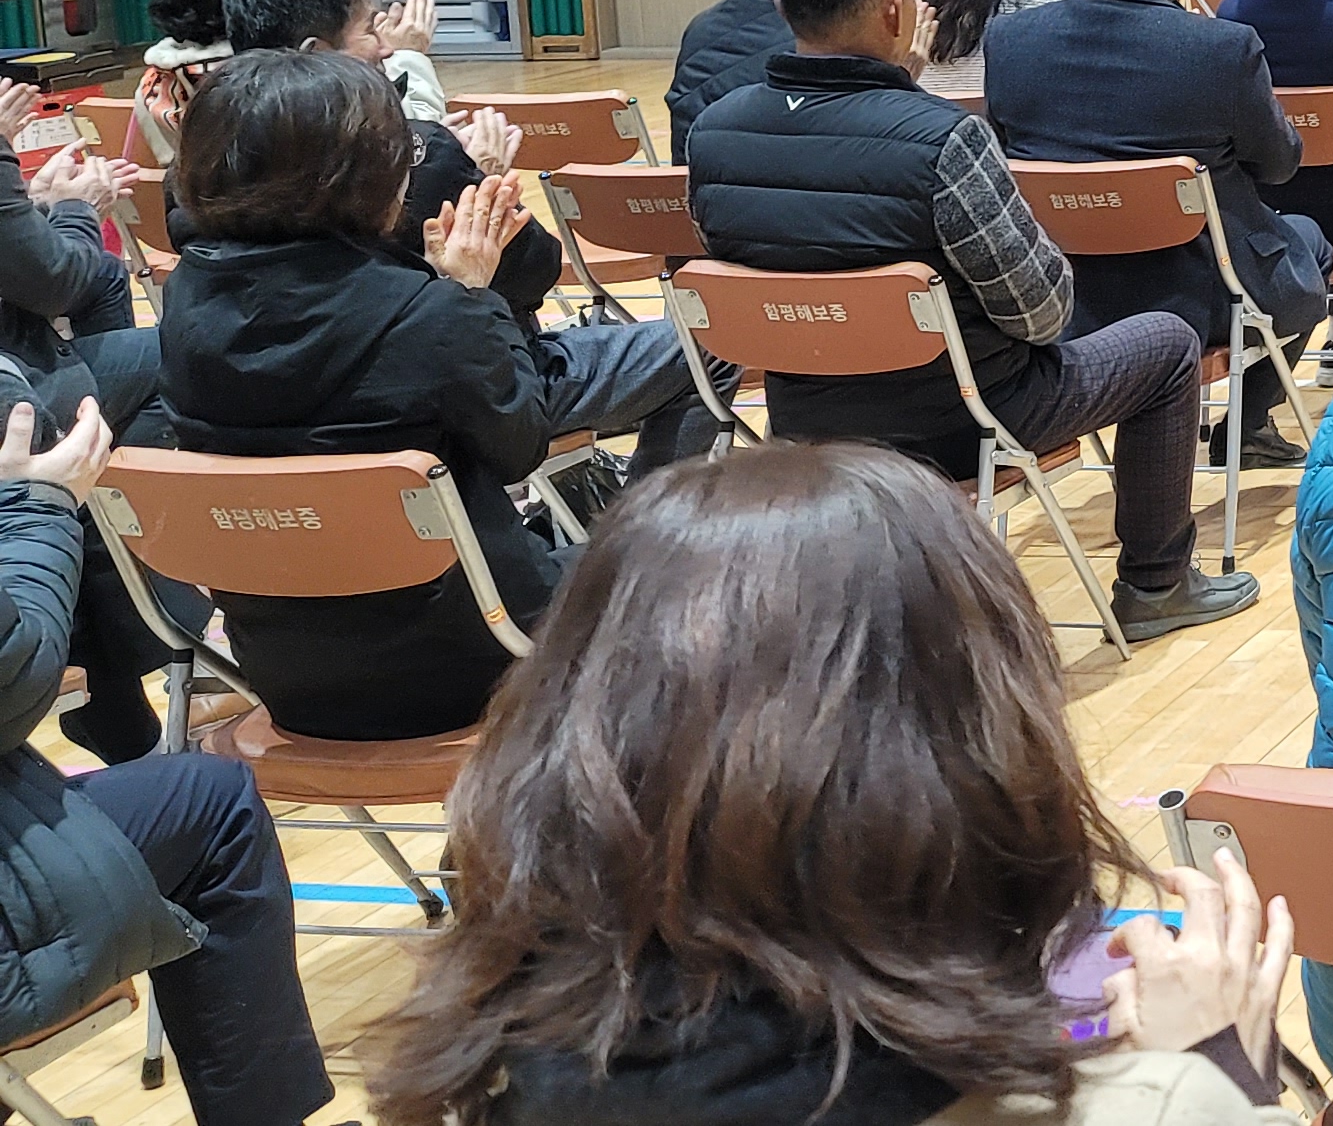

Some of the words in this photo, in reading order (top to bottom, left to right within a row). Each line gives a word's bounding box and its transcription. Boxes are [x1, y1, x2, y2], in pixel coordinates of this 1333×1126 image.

[1049, 192, 1123, 210] 함평해보중
[762, 302, 849, 323] 함평해보중
[210, 506, 322, 531] 함평해보중
